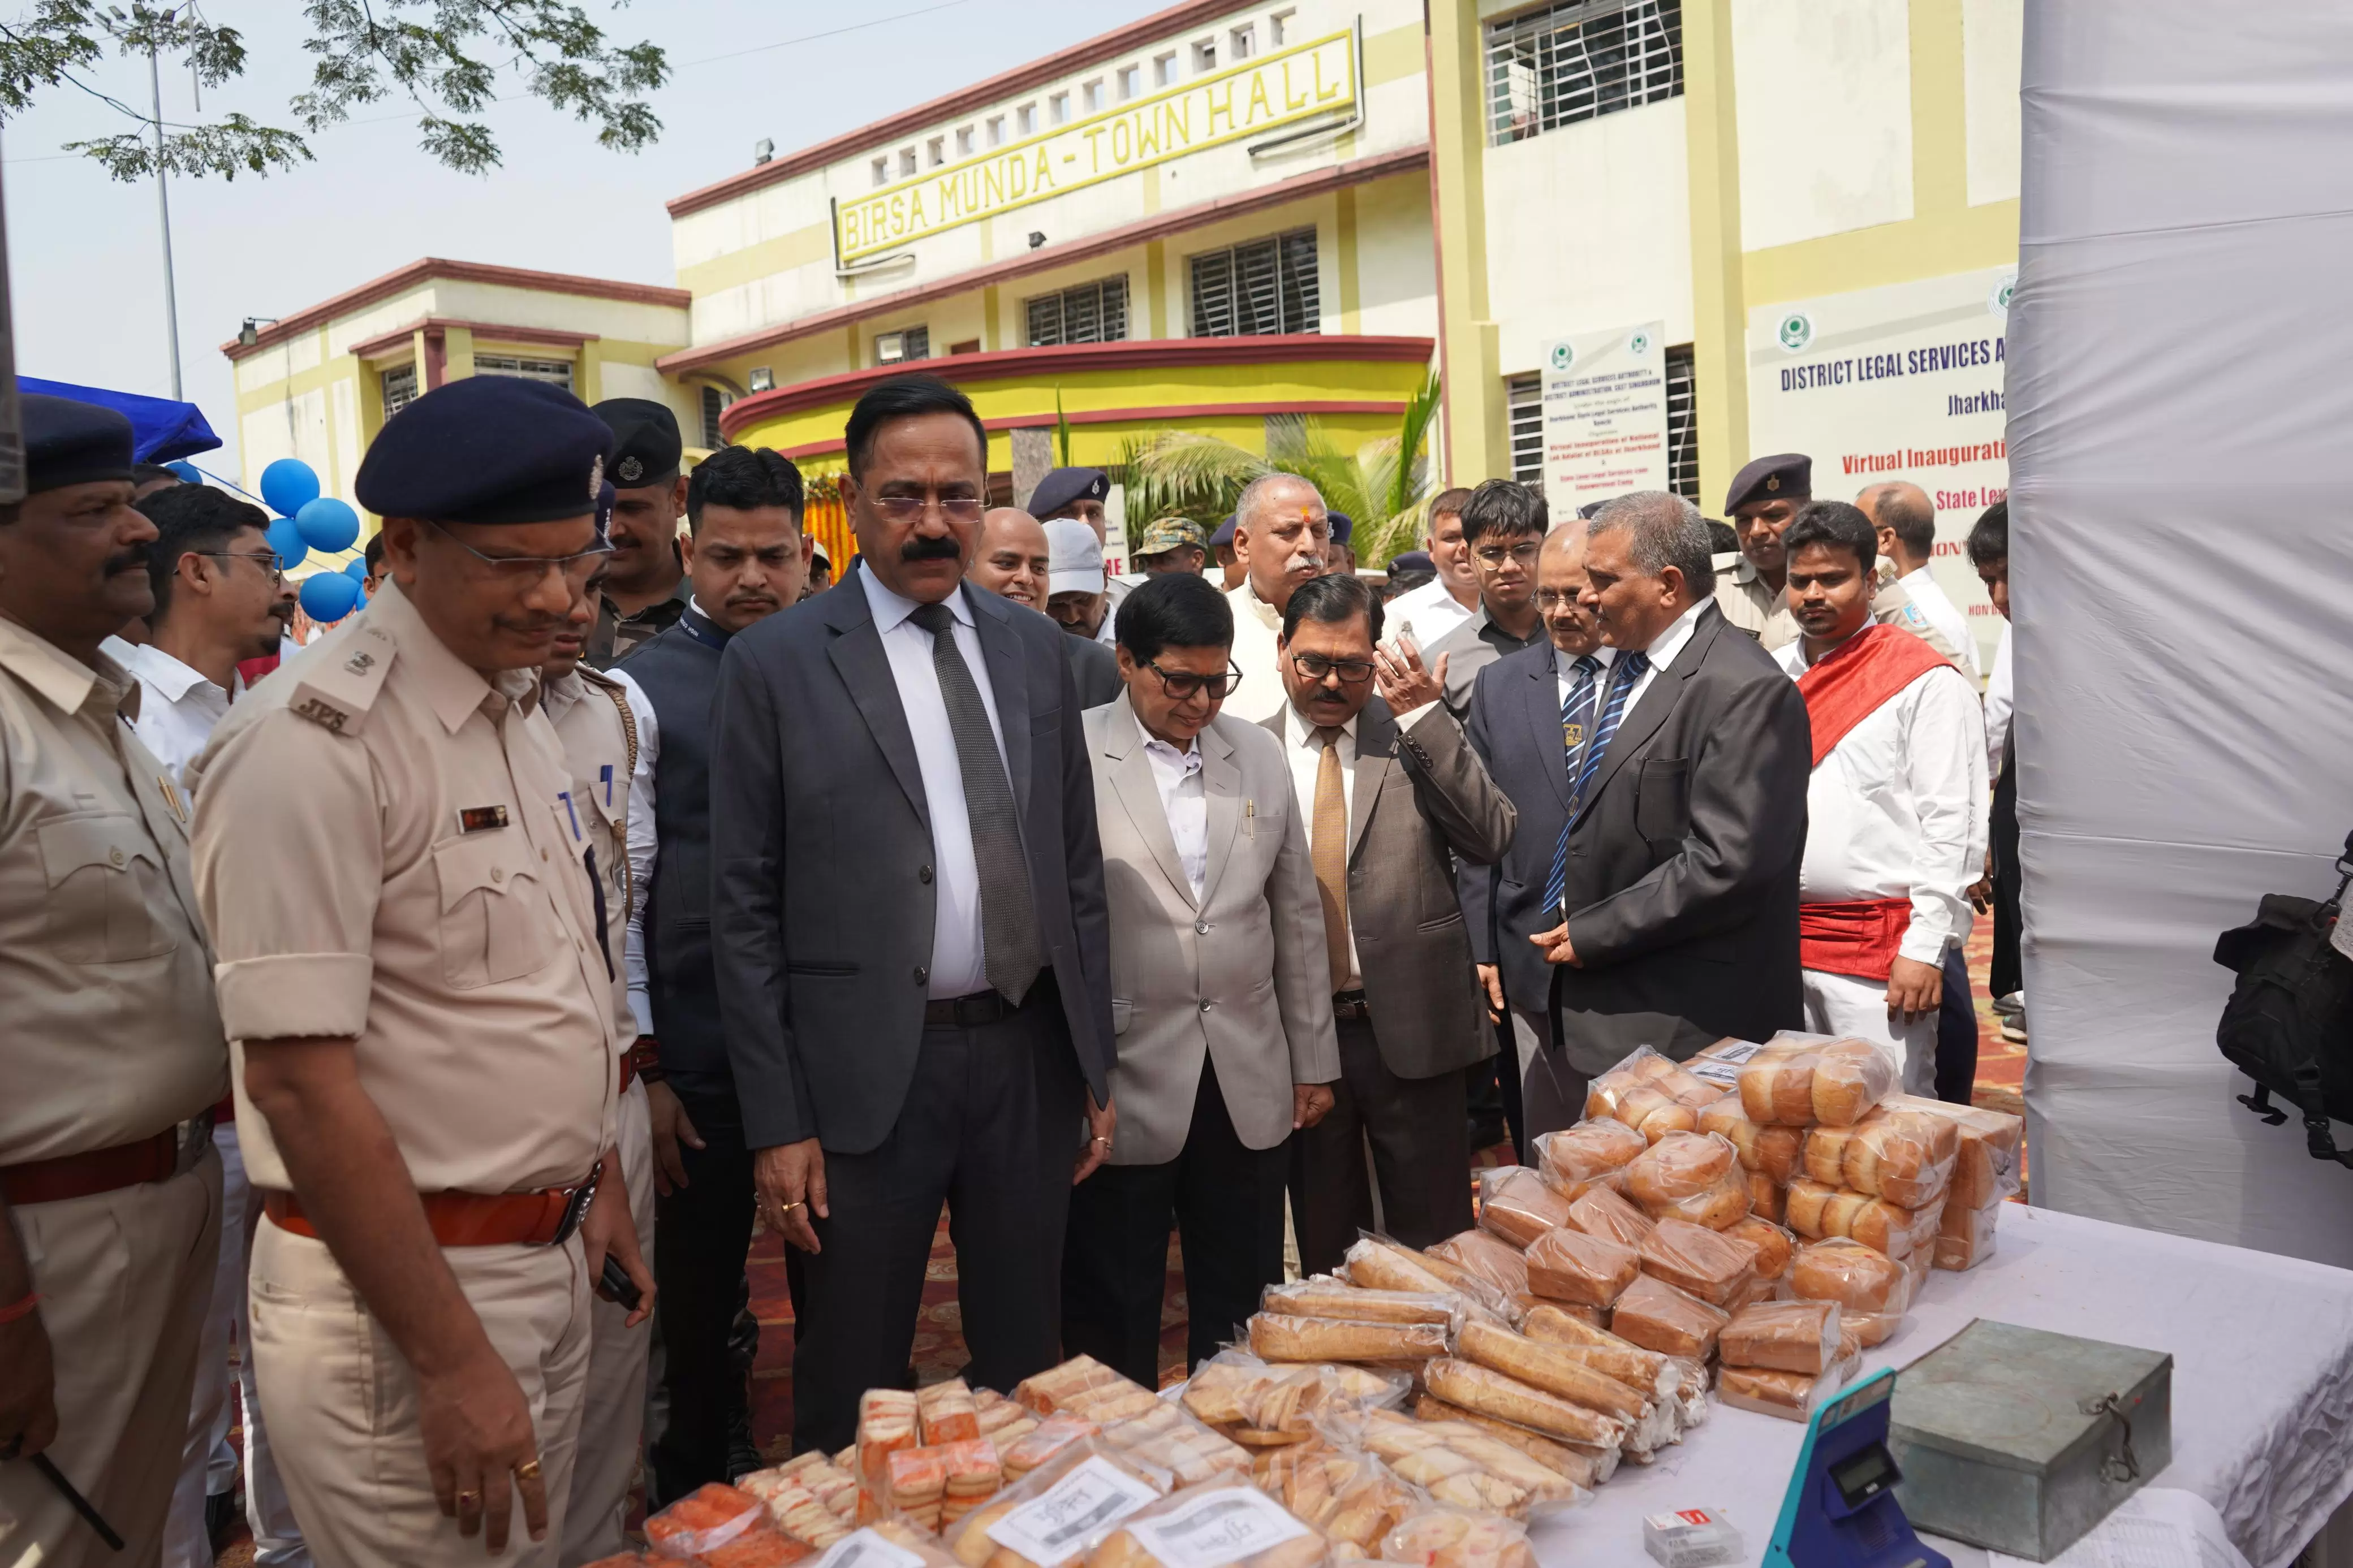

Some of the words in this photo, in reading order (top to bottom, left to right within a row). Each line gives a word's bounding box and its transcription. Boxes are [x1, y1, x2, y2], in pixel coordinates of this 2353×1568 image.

[846, 188, 928, 251] BIRSA
[939, 145, 1056, 222] MUNDA
[1083, 96, 1191, 173] TOWN
[1206, 50, 1340, 136] HALL
[1781, 359, 1854, 391] DISTRICT
[1858, 352, 1904, 382] LEGAL
[1908, 339, 1990, 374] SERVICES
[1842, 450, 1902, 474] Virtual
[1908, 439, 2006, 468] Inaugurati
[1936, 490, 1977, 510] State
[687, 627, 699, 637] HIGH
